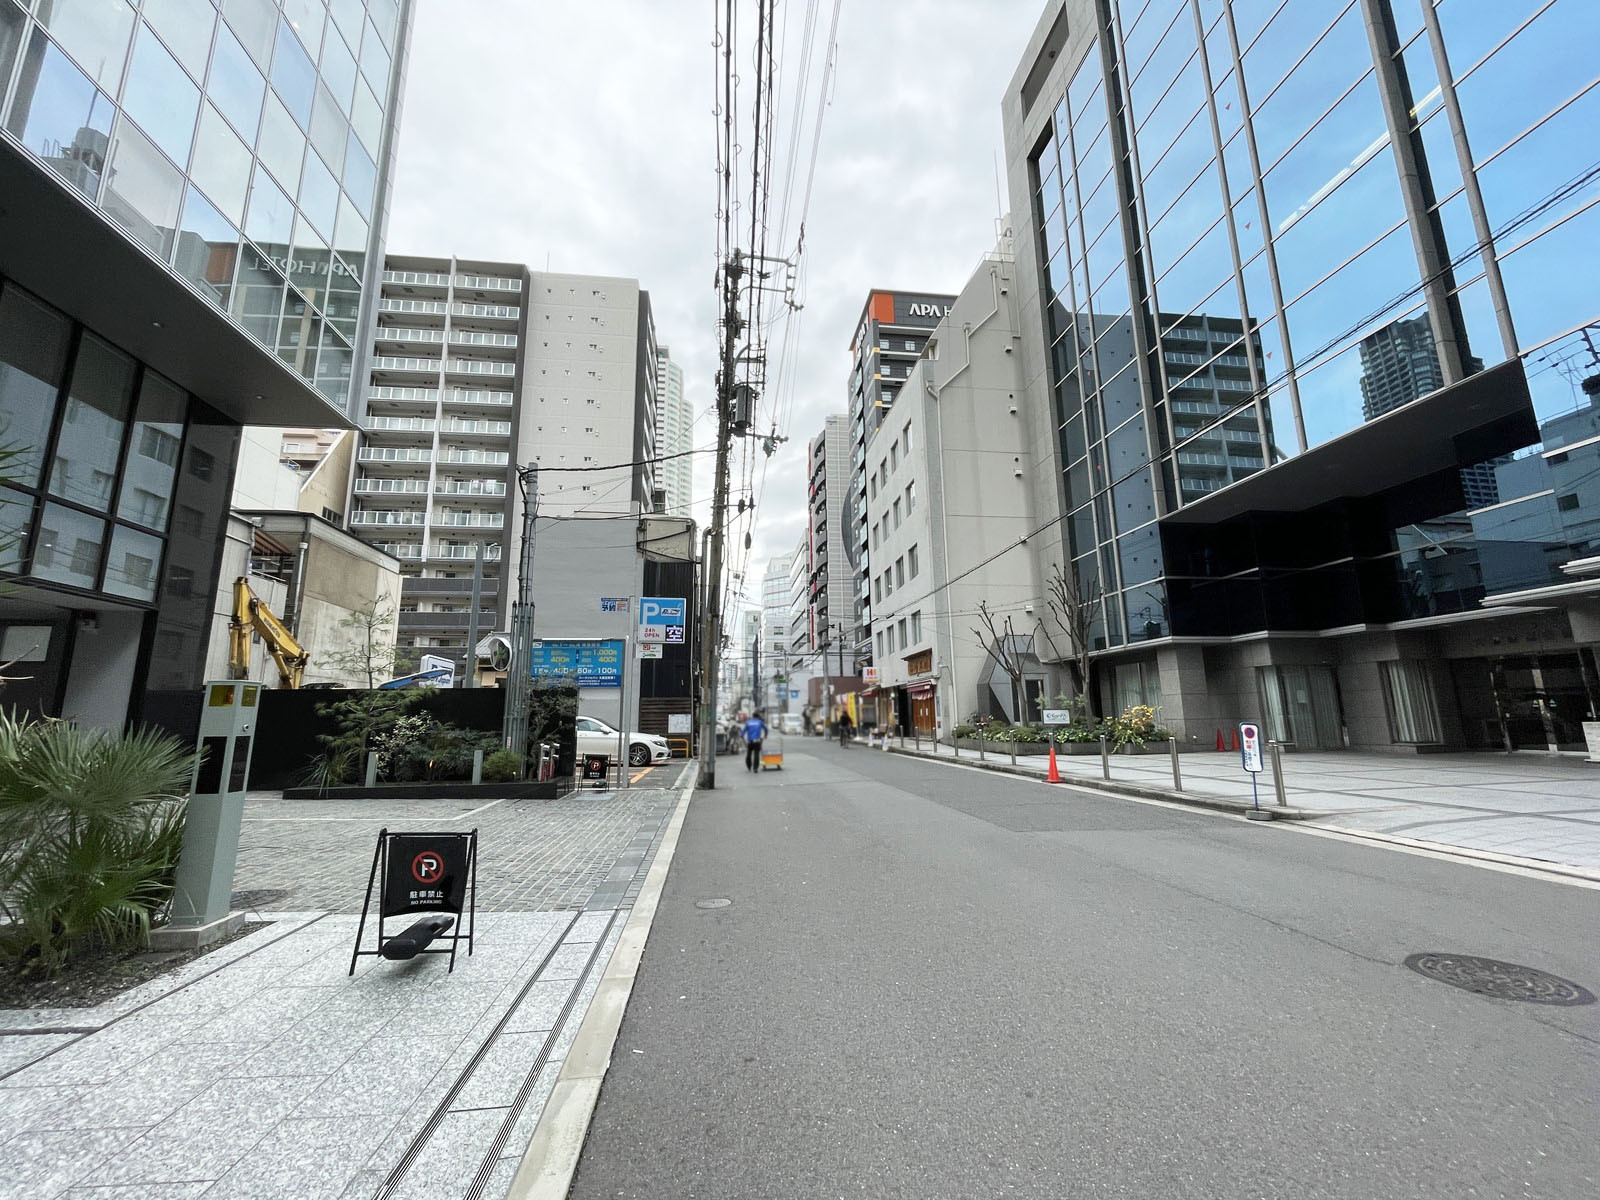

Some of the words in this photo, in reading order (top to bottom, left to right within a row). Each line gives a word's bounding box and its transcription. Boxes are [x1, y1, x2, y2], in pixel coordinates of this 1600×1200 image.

[909, 303, 941, 317] APA
[642, 602, 660, 625] P
[666, 625, 683, 642] 空
[409, 890, 444, 898] 駐車禁止
